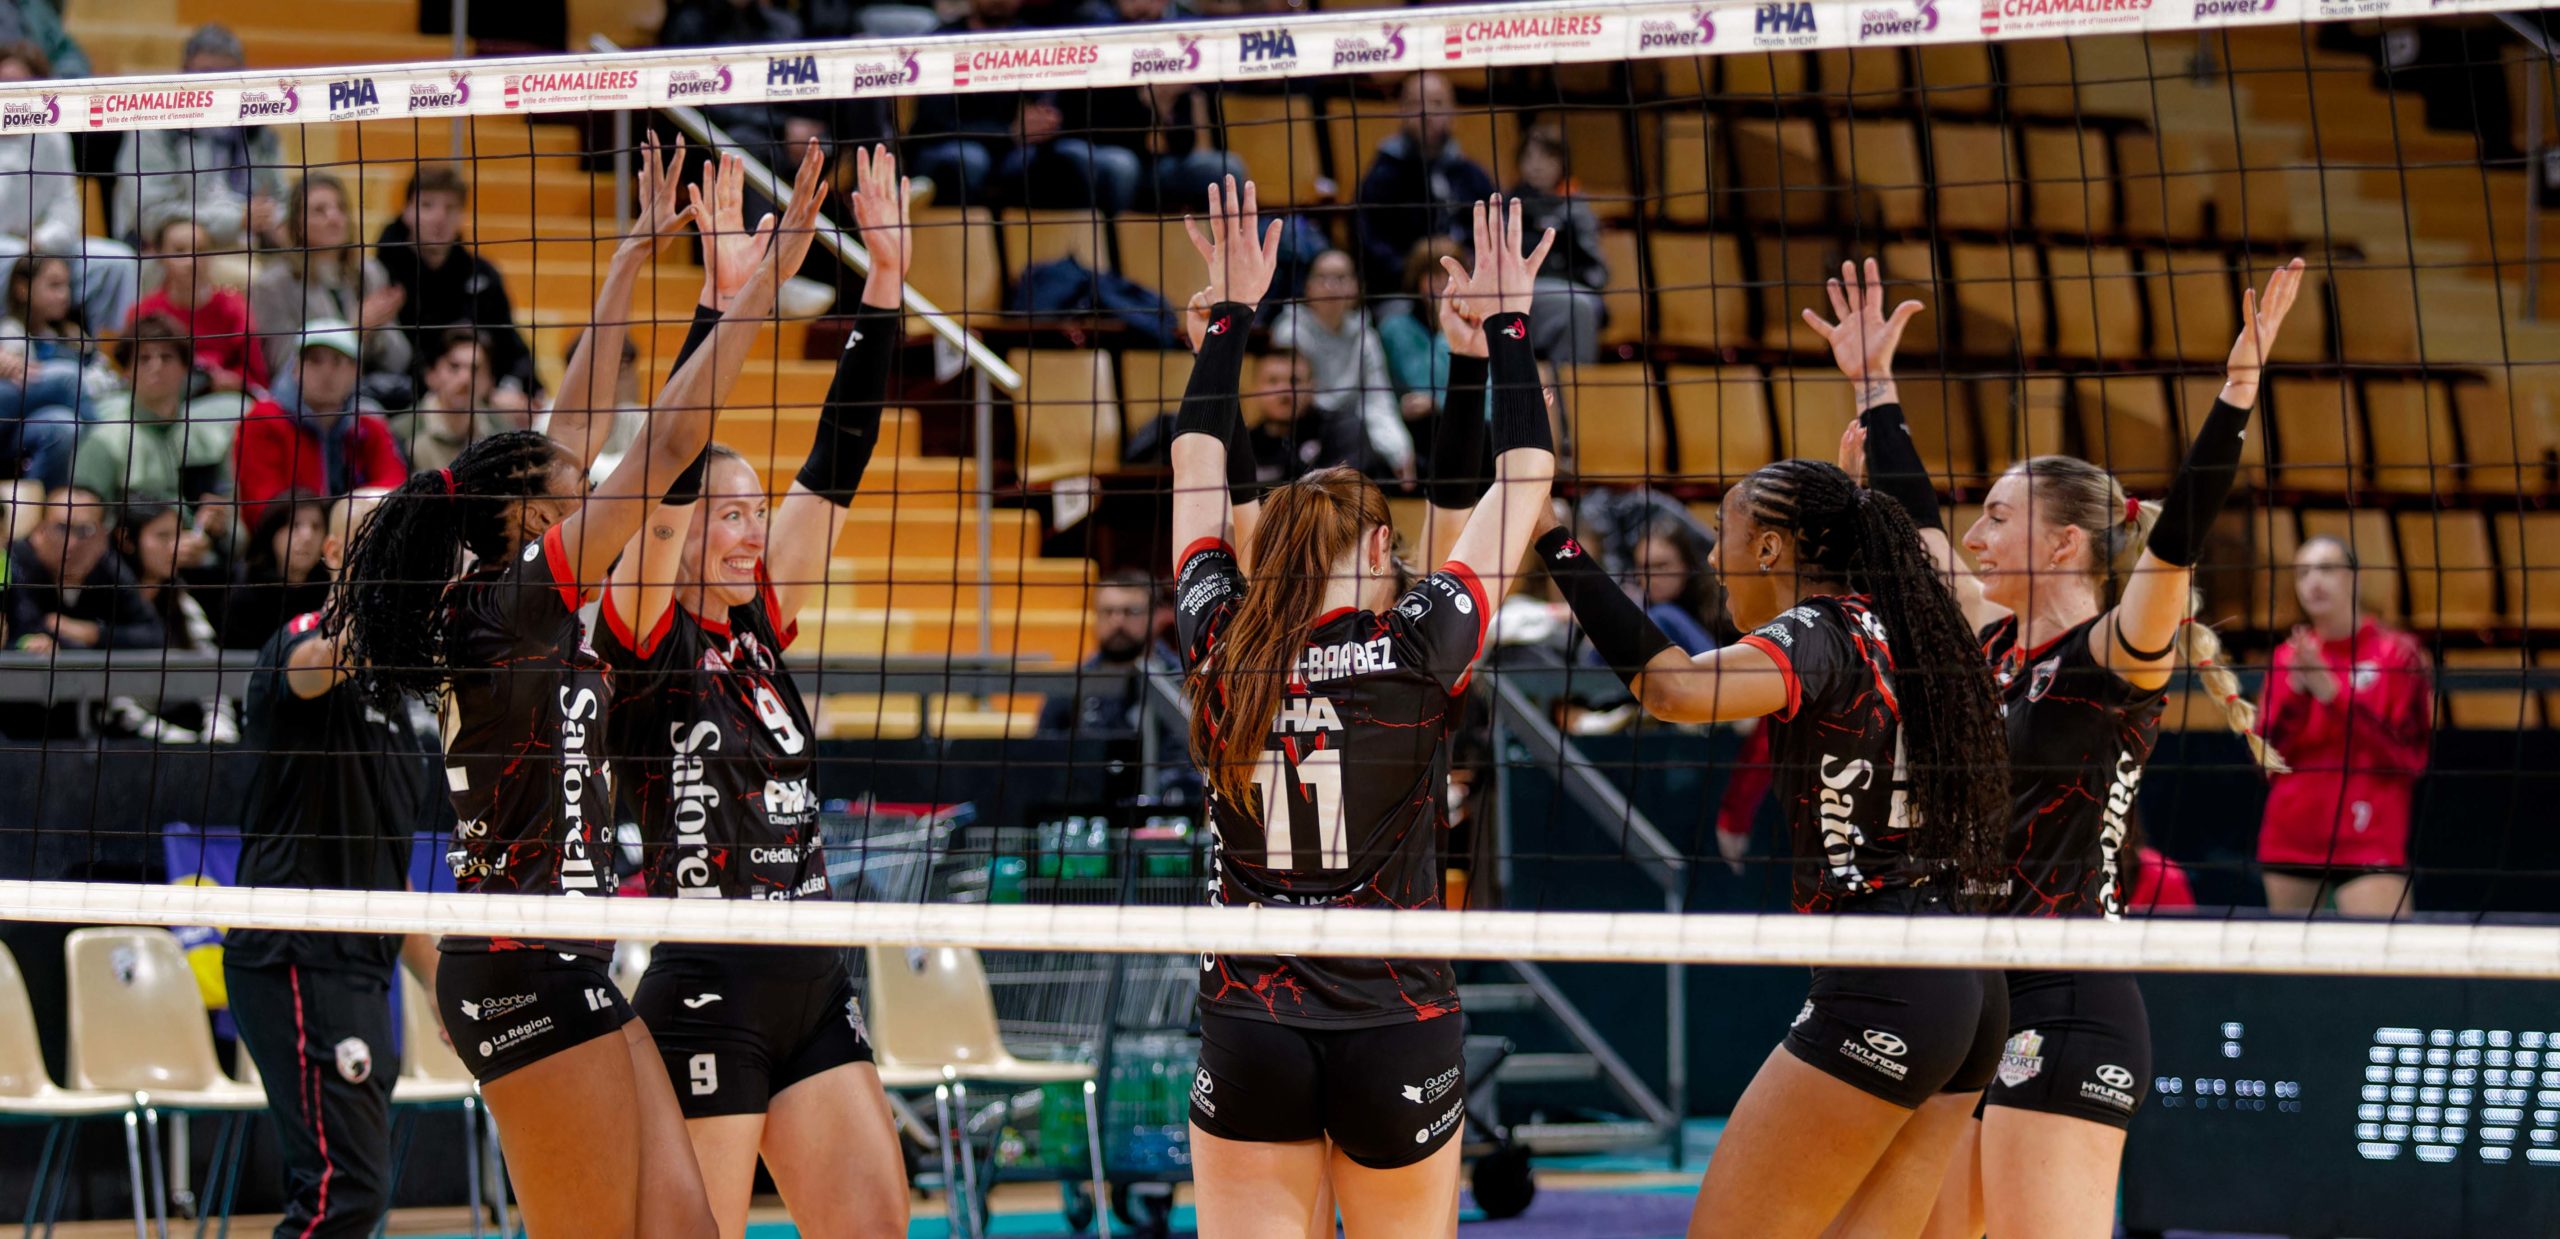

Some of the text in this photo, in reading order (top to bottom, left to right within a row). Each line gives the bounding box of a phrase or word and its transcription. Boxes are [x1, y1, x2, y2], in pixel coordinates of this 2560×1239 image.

[1754, 2, 1817, 34] PHA
[1239, 28, 1296, 62] PHA
[767, 55, 819, 85] PHA
[106, 88, 214, 112] CHAMALIÈRES
[329, 78, 379, 111] PHA
[538, 95, 546, 103] de
[580, 93, 587, 101] et
[160, 112, 167, 120] et
[168, 111, 204, 119] d'innovation
[330, 108, 379, 122] Claude MICHY
[754, 686, 805, 754] 9
[1250, 749, 1349, 869] 11
[492, 1016, 552, 1046] La Région
[1843, 1039, 1908, 1075] HYUNDAI
[689, 1053, 718, 1095] 9
